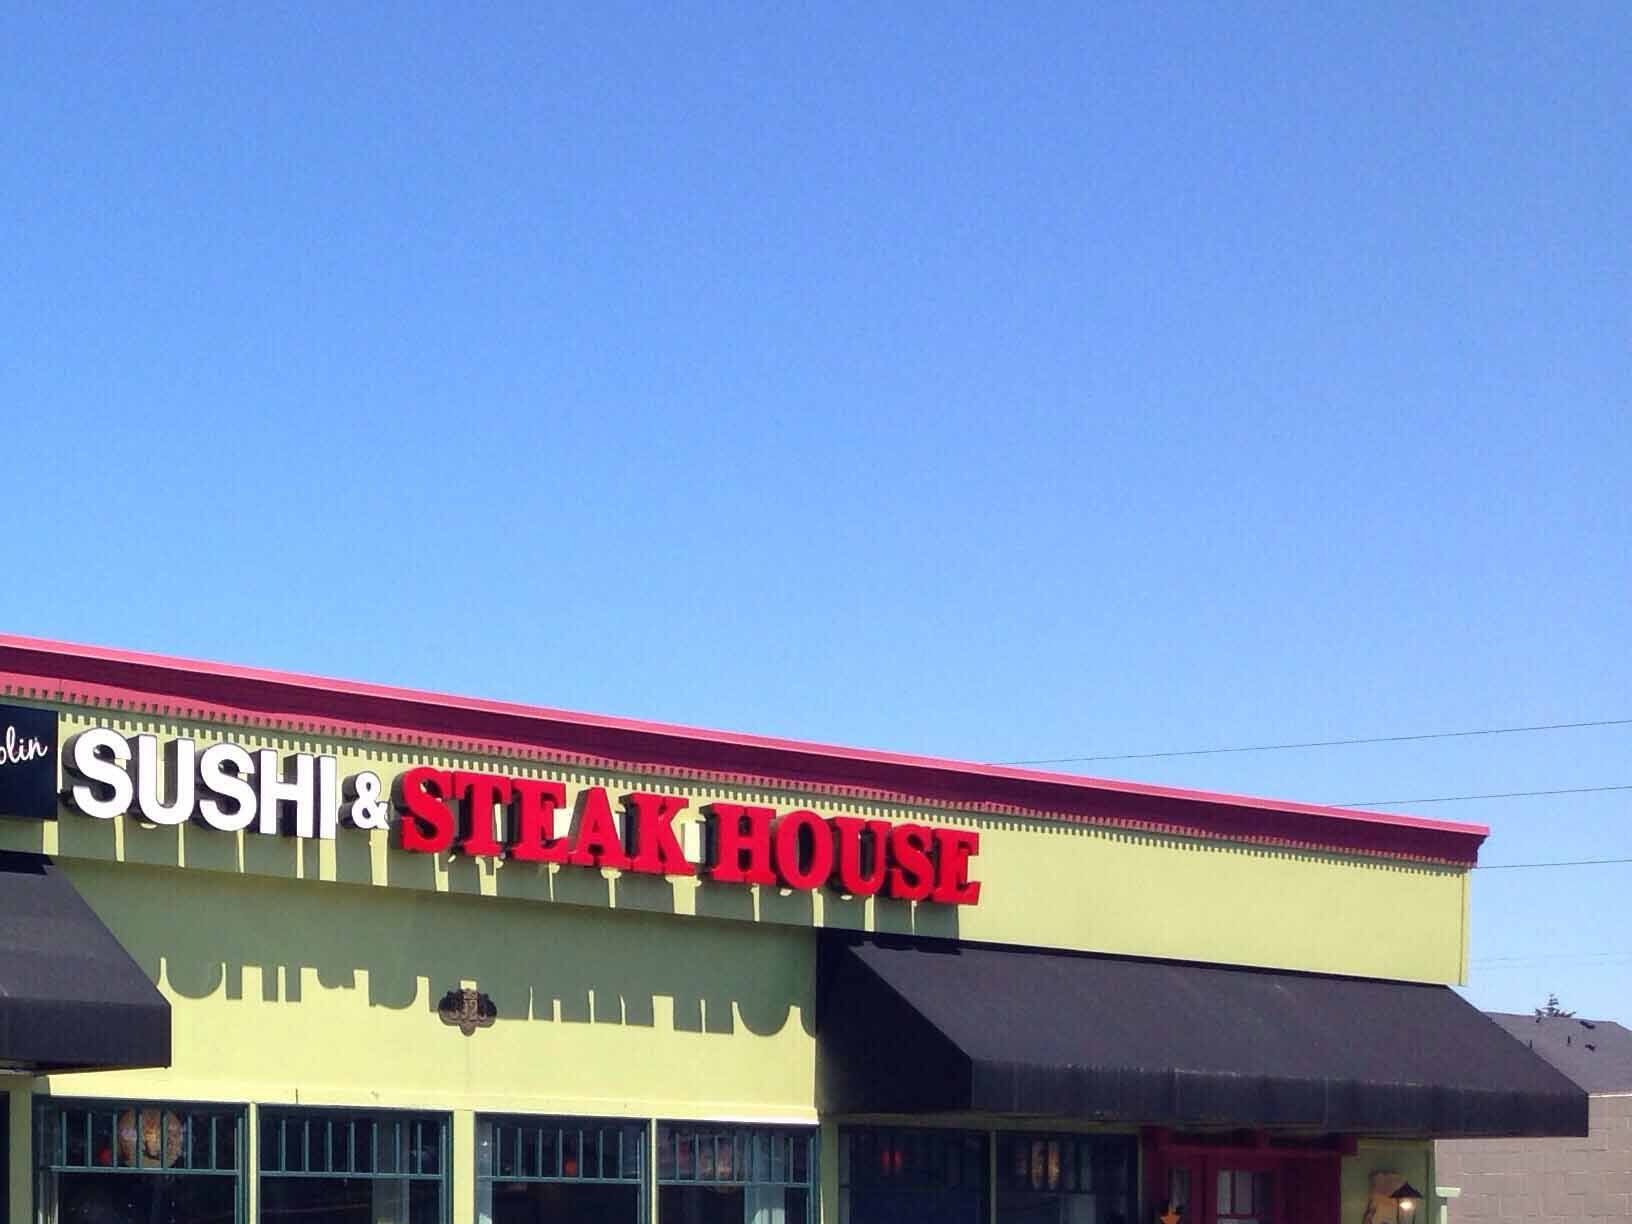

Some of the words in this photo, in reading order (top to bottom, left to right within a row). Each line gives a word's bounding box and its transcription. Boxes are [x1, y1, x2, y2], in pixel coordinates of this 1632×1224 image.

[68, 726, 337, 840] SUSHI
[349, 770, 390, 830] &
[398, 766, 696, 876] STEAK
[710, 802, 981, 906] HOUSE
